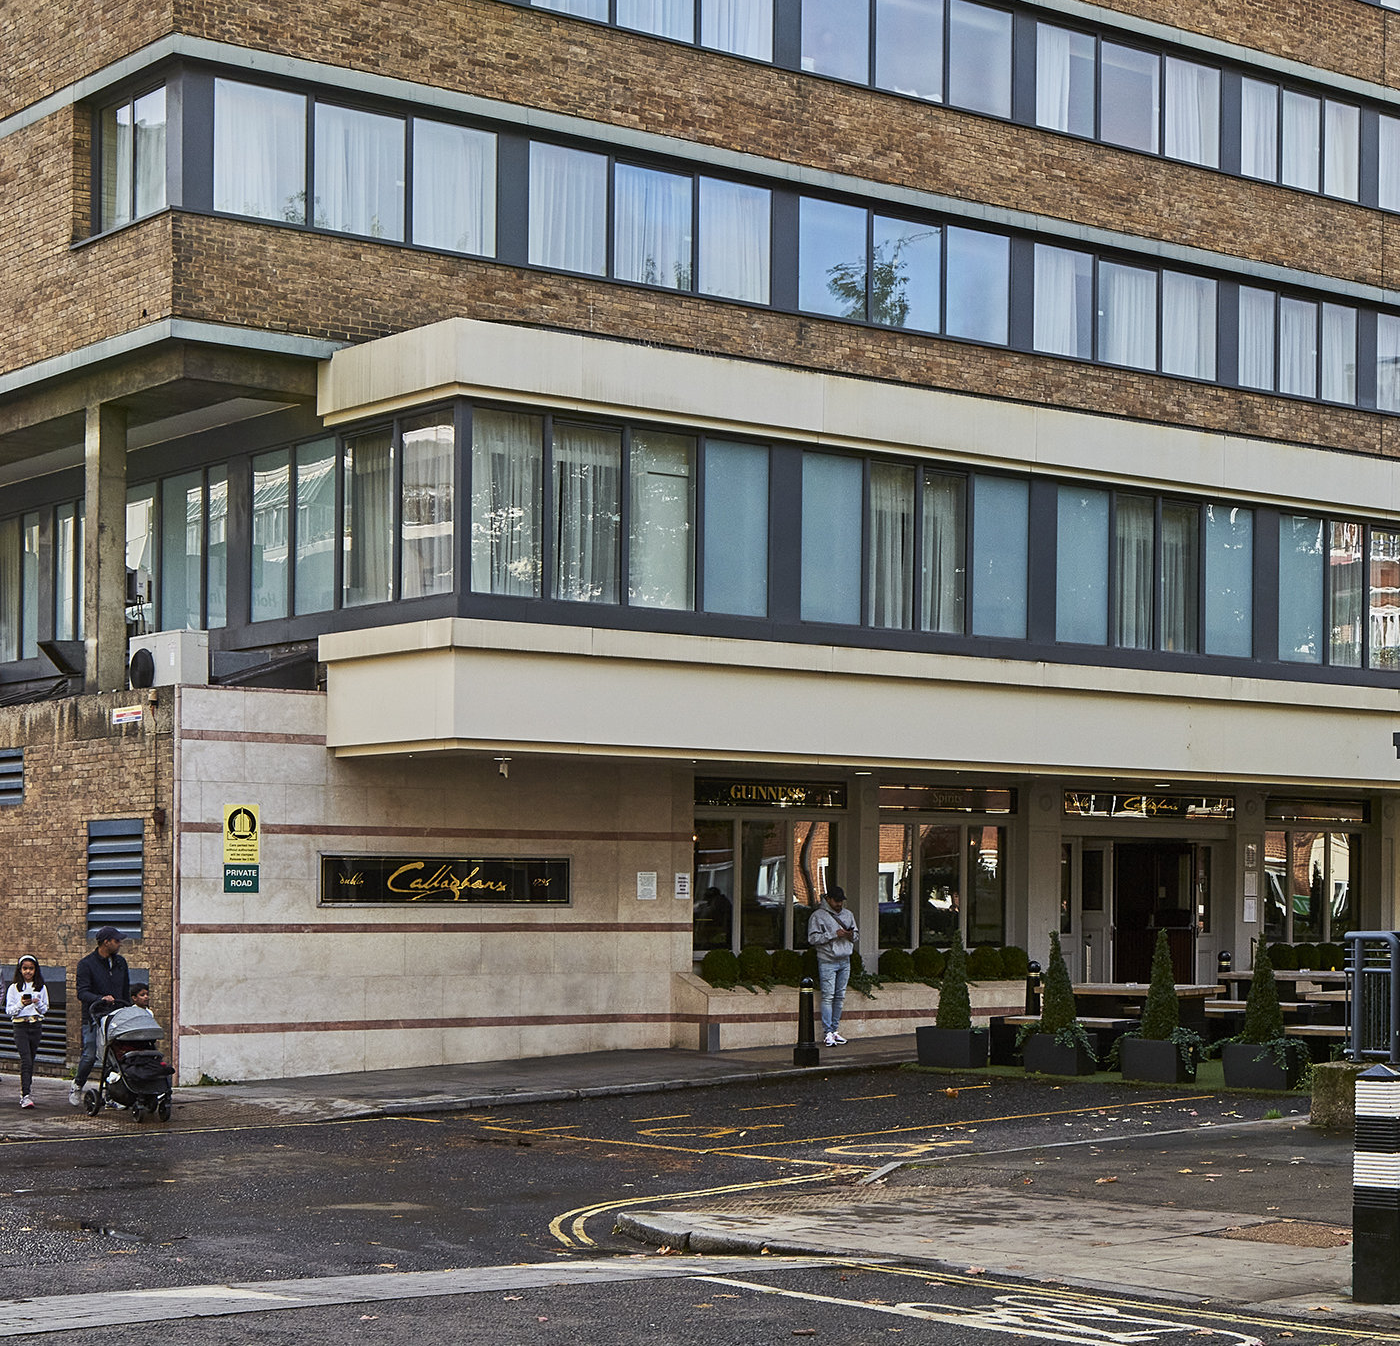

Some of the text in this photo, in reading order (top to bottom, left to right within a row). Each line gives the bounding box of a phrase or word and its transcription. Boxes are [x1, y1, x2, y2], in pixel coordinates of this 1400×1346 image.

[730, 784, 806, 802] GUINNESS
[933, 792, 963, 806] Spirits
[387, 861, 507, 901] Callaghans
